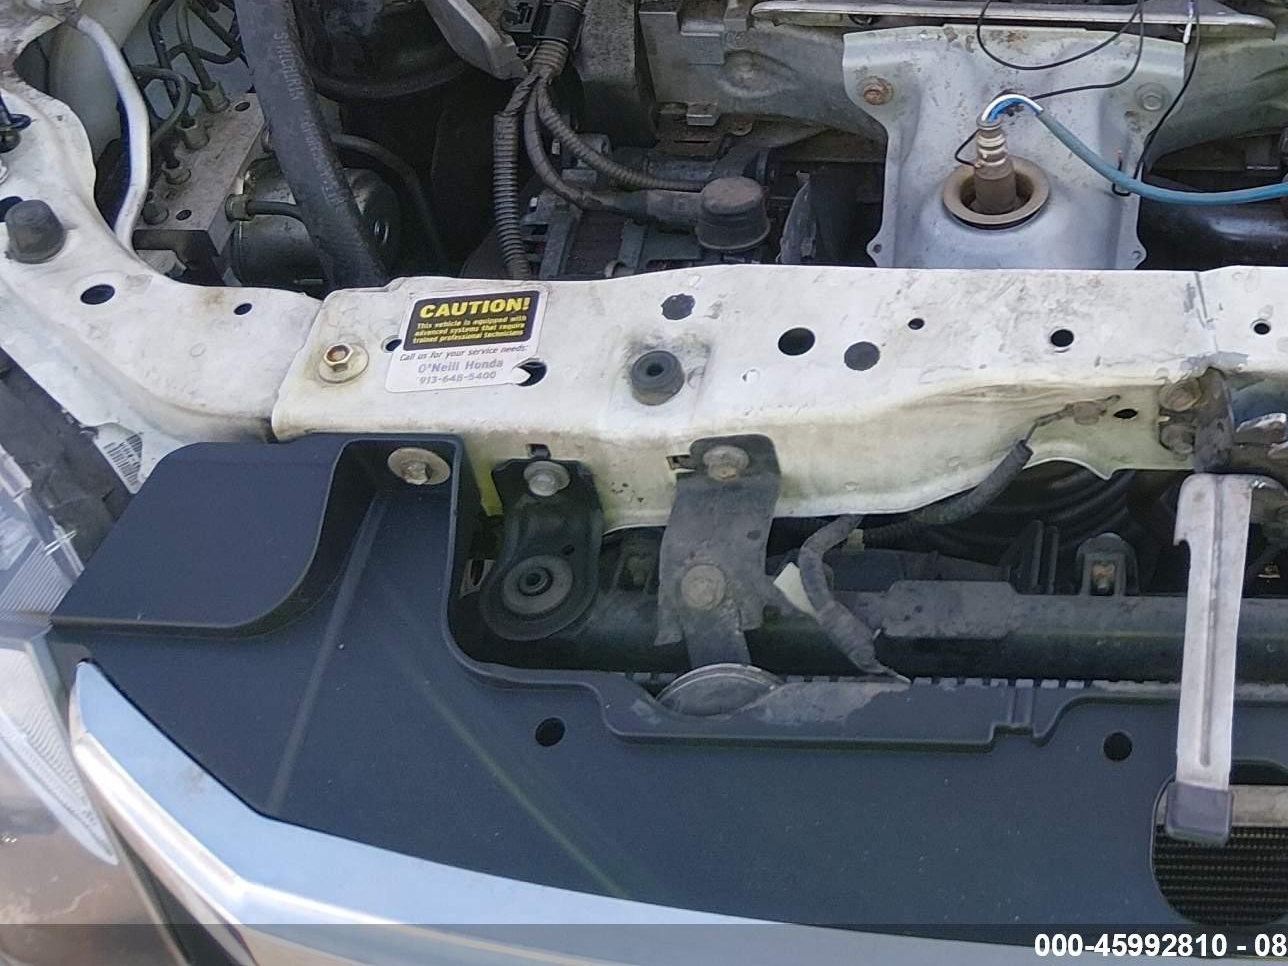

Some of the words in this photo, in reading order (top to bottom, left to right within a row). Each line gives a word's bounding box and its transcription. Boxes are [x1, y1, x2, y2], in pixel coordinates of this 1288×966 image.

[419, 297, 531, 319] CAUTION!
[414, 327, 448, 336] advanced
[450, 326, 479, 335] systems
[480, 323, 497, 331] that
[499, 322, 526, 332] require
[417, 322, 432, 330] This
[434, 320, 462, 328] vehicle
[472, 316, 508, 326] equipped
[510, 315, 527, 323] with
[412, 336, 438, 344] trained
[439, 333, 482, 343] professional
[430, 351, 442, 359] for
[445, 350, 465, 359] your
[468, 348, 498, 356] service
[418, 362, 459, 373] O'Neill
[465, 359, 503, 370] Honda
[420, 372, 496, 384] 913-648-5400
